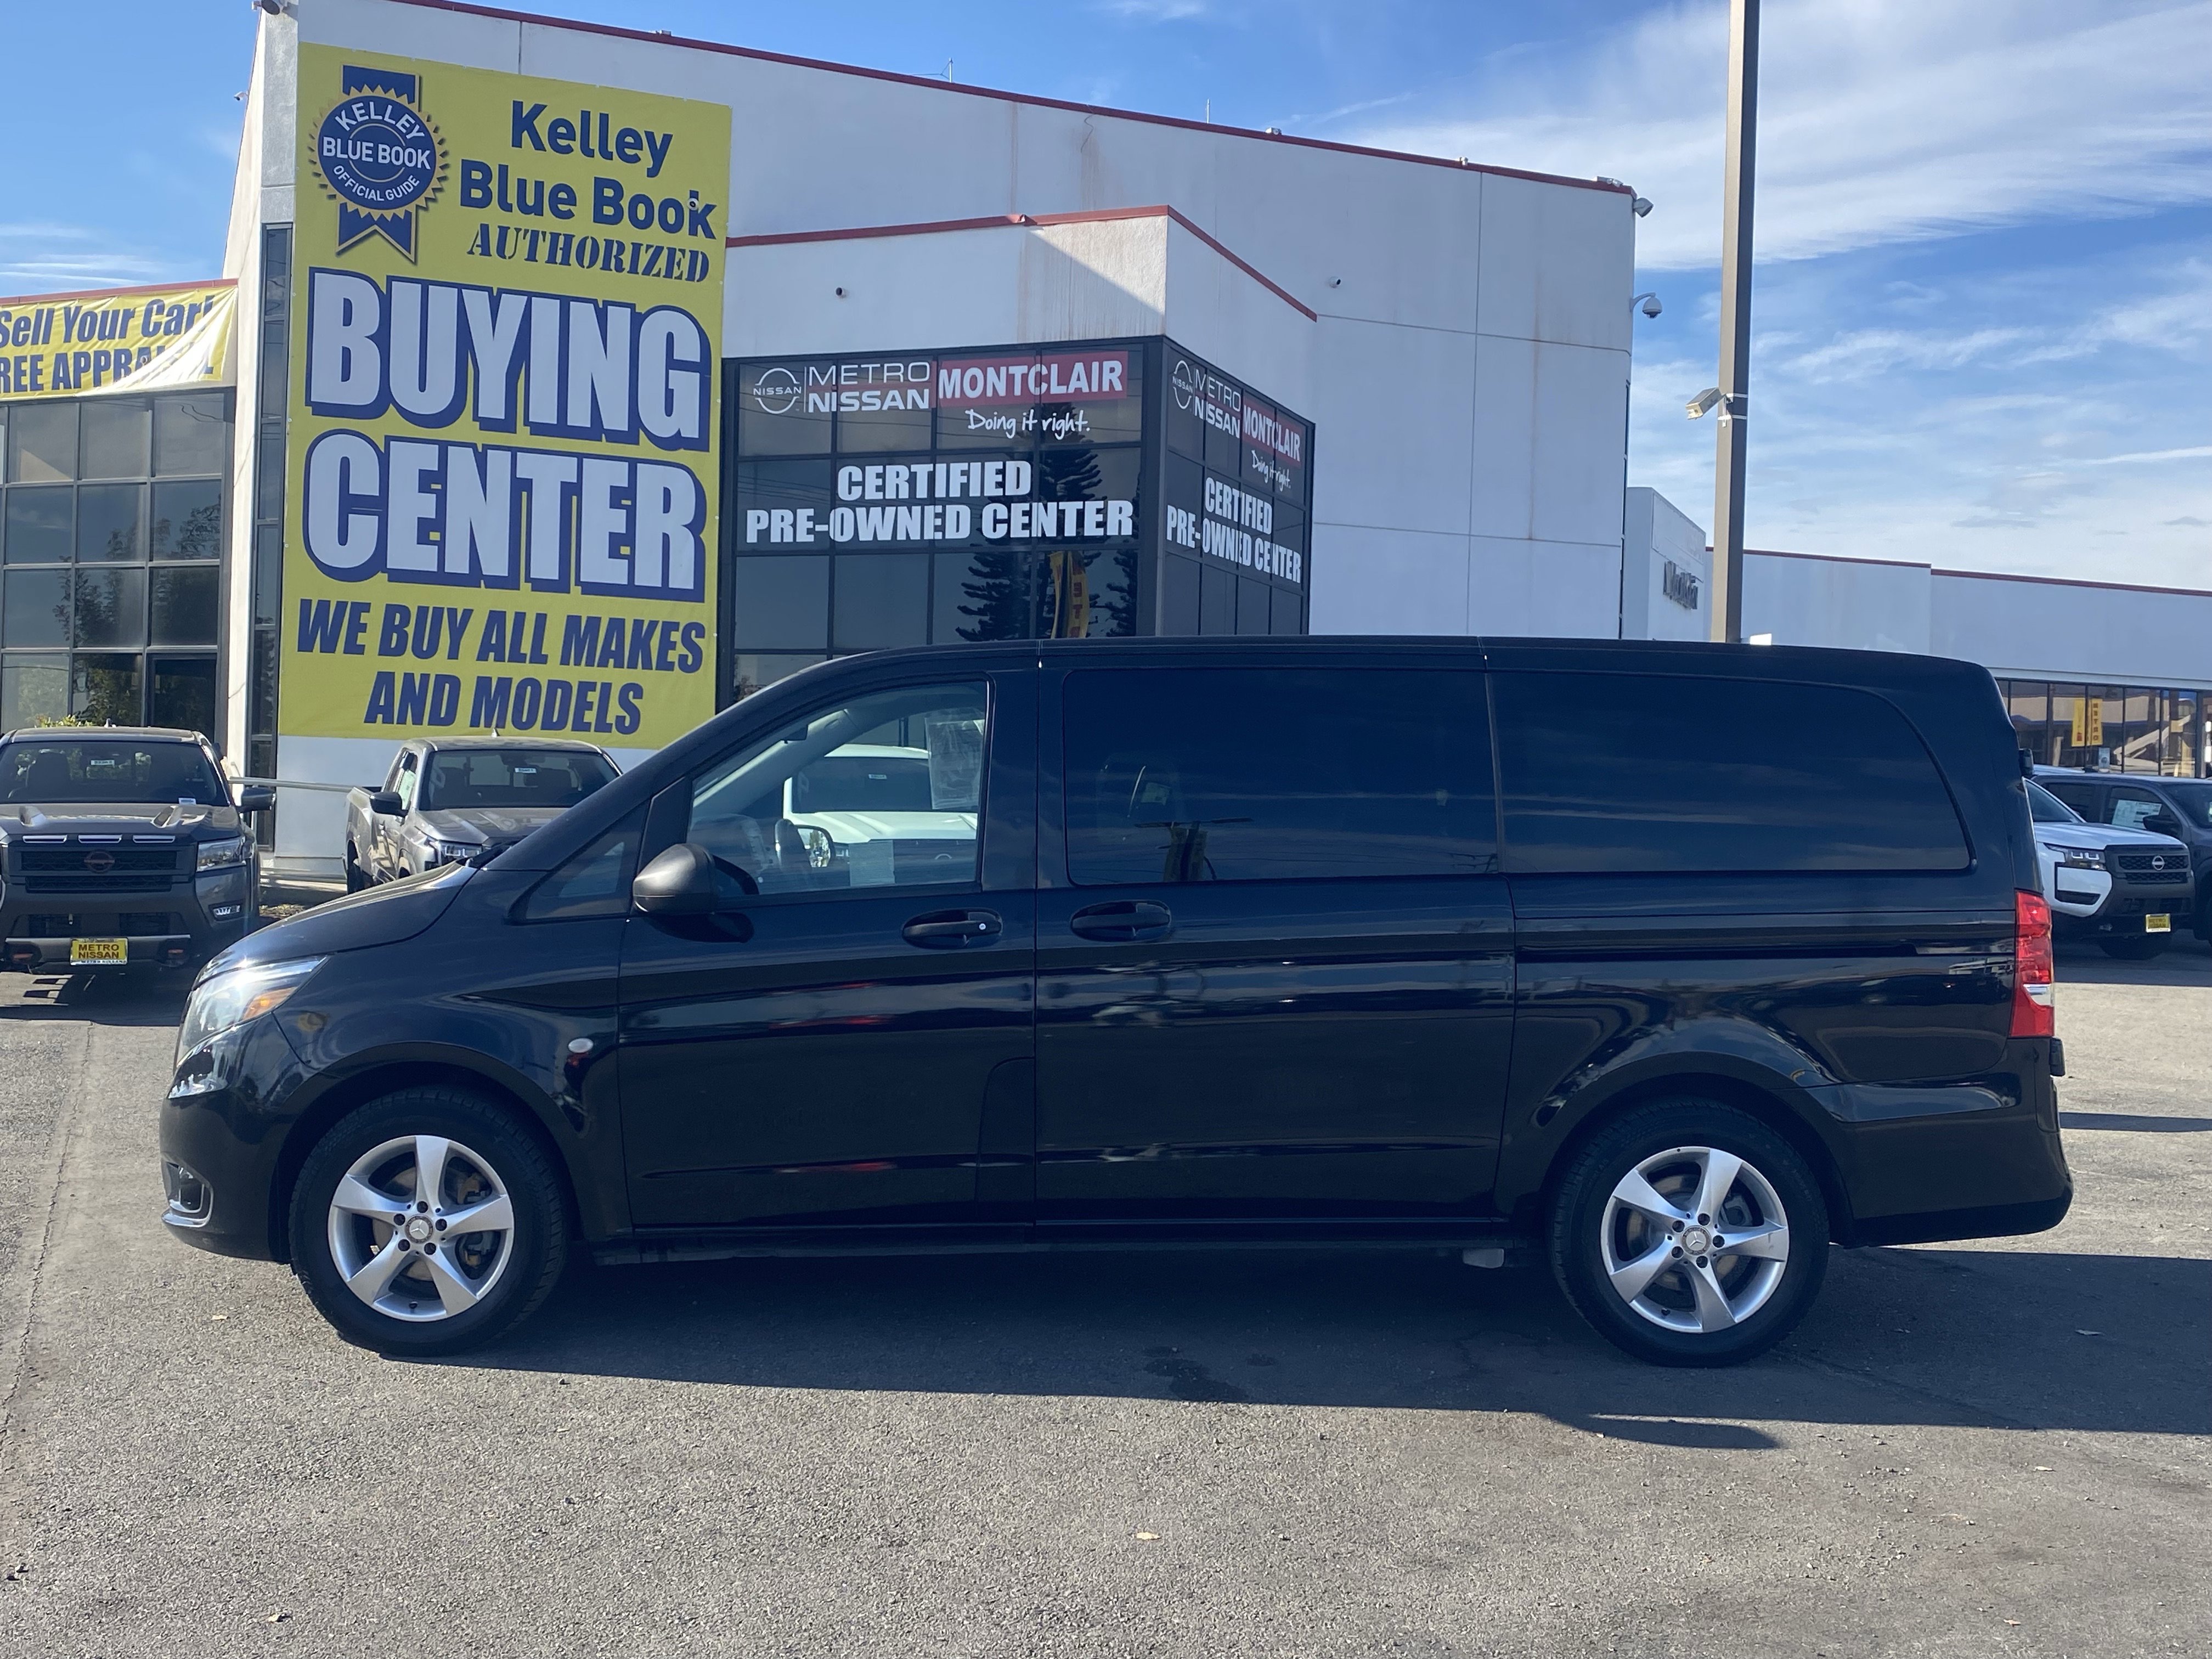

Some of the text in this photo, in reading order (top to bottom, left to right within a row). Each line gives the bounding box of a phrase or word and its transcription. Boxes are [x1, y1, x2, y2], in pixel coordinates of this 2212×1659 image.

[335, 101, 425, 139] KELLEY
[511, 100, 673, 178] Kelley
[323, 137, 431, 170] BLUE BOOK
[333, 165, 420, 201] OFFICIAL GUIDE
[460, 159, 717, 240] Blue Book
[466, 223, 710, 283] AUTHORIZED
[0, 308, 55, 348] Sell
[63, 306, 136, 343] Your
[307, 268, 708, 445] BUYING
[809, 362, 930, 386] METRO
[753, 386, 802, 396] NISSAN
[808, 388, 929, 413] NISSAN
[939, 360, 1123, 399] MONTCLAIR
[1172, 376, 1193, 394] NISSAN
[1195, 369, 1241, 413] METRO
[965, 409, 1090, 439] Doing it right.
[1195, 396, 1240, 439] NISSAN
[1243, 405, 1300, 462] MONTCLAIR
[837, 460, 1031, 501] CERTIFIED
[1251, 450, 1269, 484] Doing
[1269, 460, 1276, 479] it
[305, 430, 702, 596] CENTER
[746, 500, 1133, 543] PRE-OWNED CENTER
[1205, 477, 1272, 535] CERTIFIED
[1167, 505, 1301, 583] PRE-OWNED CENTER
[297, 598, 706, 674] WE BUY ALL MAKES
[363, 671, 644, 735] AND MODELS
